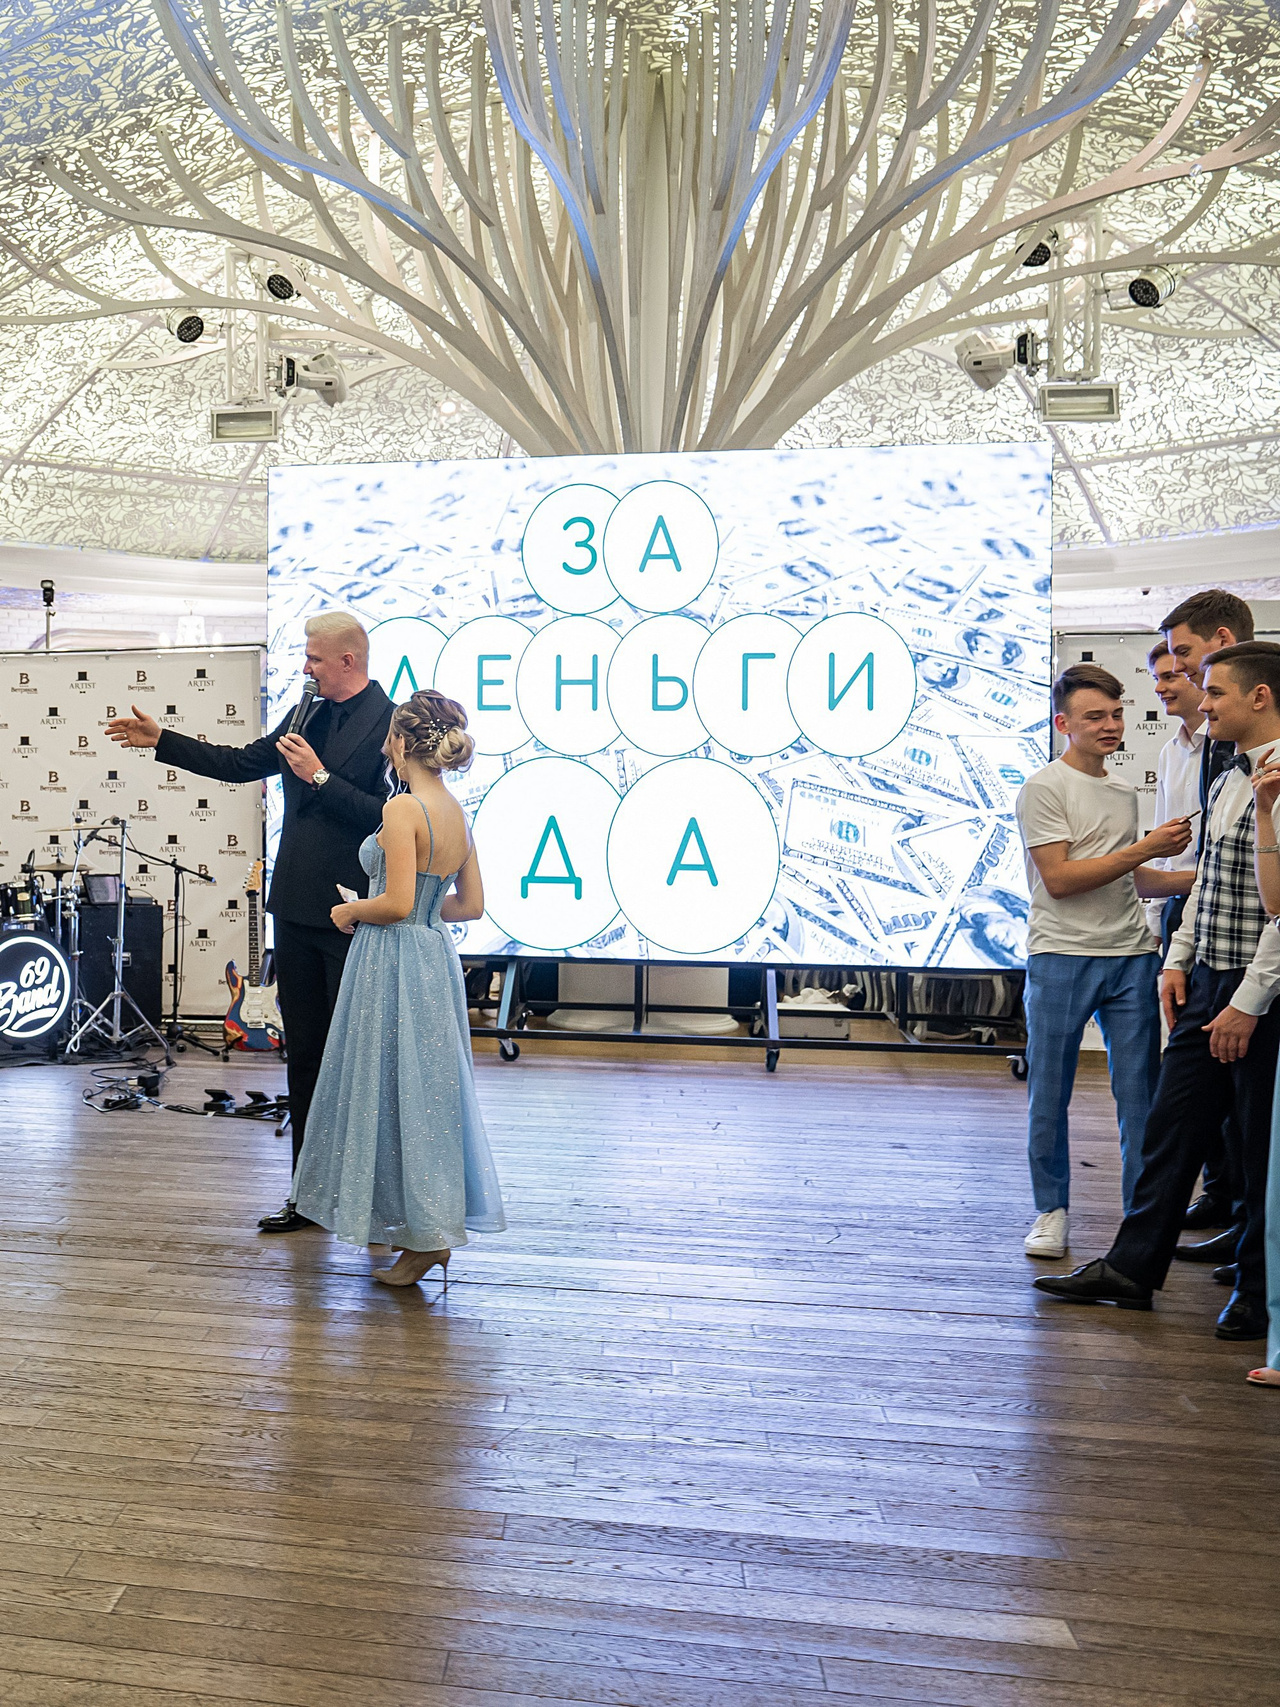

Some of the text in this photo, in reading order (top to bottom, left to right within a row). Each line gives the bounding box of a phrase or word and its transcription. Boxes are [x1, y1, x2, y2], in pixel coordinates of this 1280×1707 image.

[562, 515, 682, 575] ЗА
[69, 682, 96, 690] ARTIST
[521, 815, 718, 900] ДА
[20, 956, 51, 988] 69
